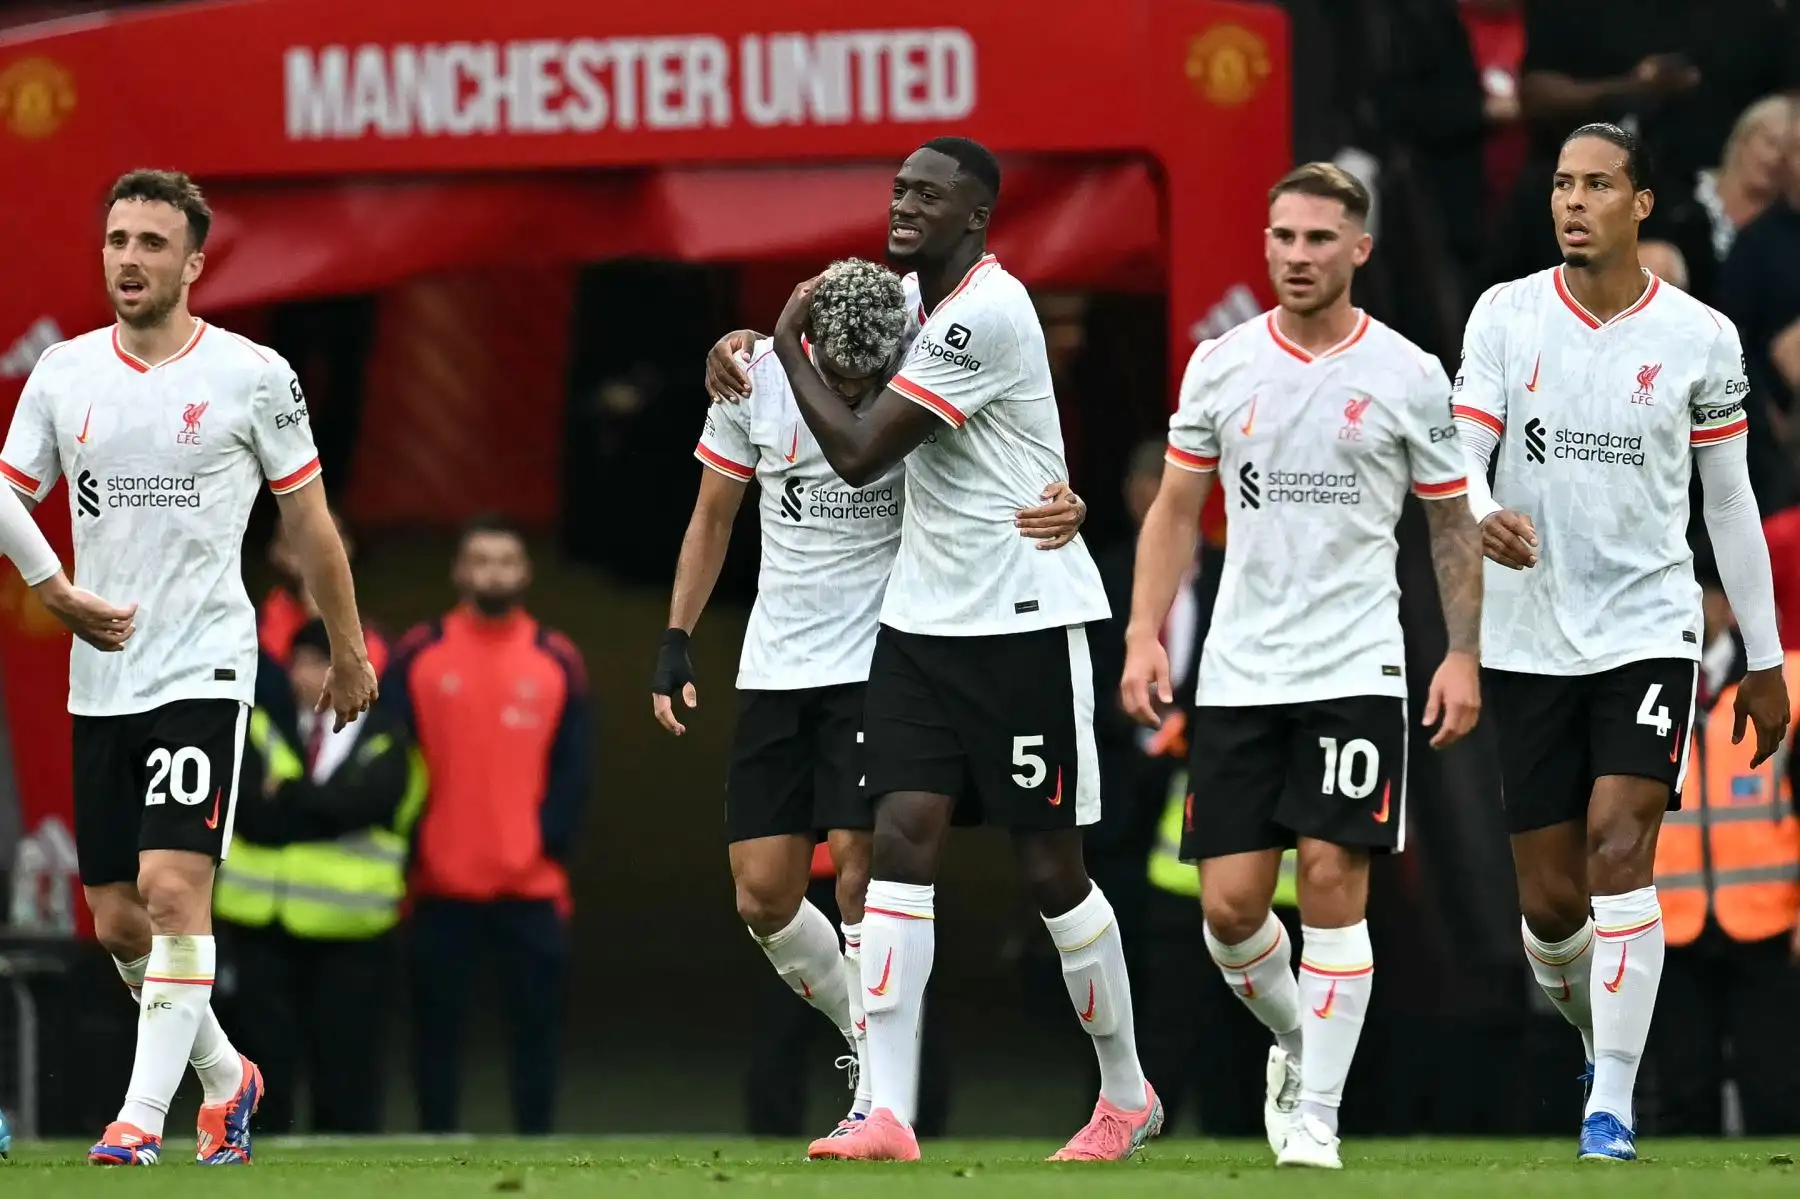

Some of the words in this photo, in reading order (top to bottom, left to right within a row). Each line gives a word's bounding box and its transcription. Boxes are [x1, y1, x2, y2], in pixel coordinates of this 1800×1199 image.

[284, 36, 731, 140] MANCHESTER
[741, 27, 975, 127] UNITED
[1554, 428, 1642, 450] standard
[1554, 444, 1645, 467] chartered
[107, 474, 195, 491] standard
[1267, 469, 1357, 488] standard
[108, 491, 200, 508] chartered
[809, 485, 893, 504] standard
[1267, 487, 1361, 505] chartered
[809, 501, 899, 520] chartered
[1636, 683, 1672, 737] 4
[1011, 734, 1047, 789] 5
[1319, 736, 1380, 799] 10
[145, 745, 211, 806] 20
